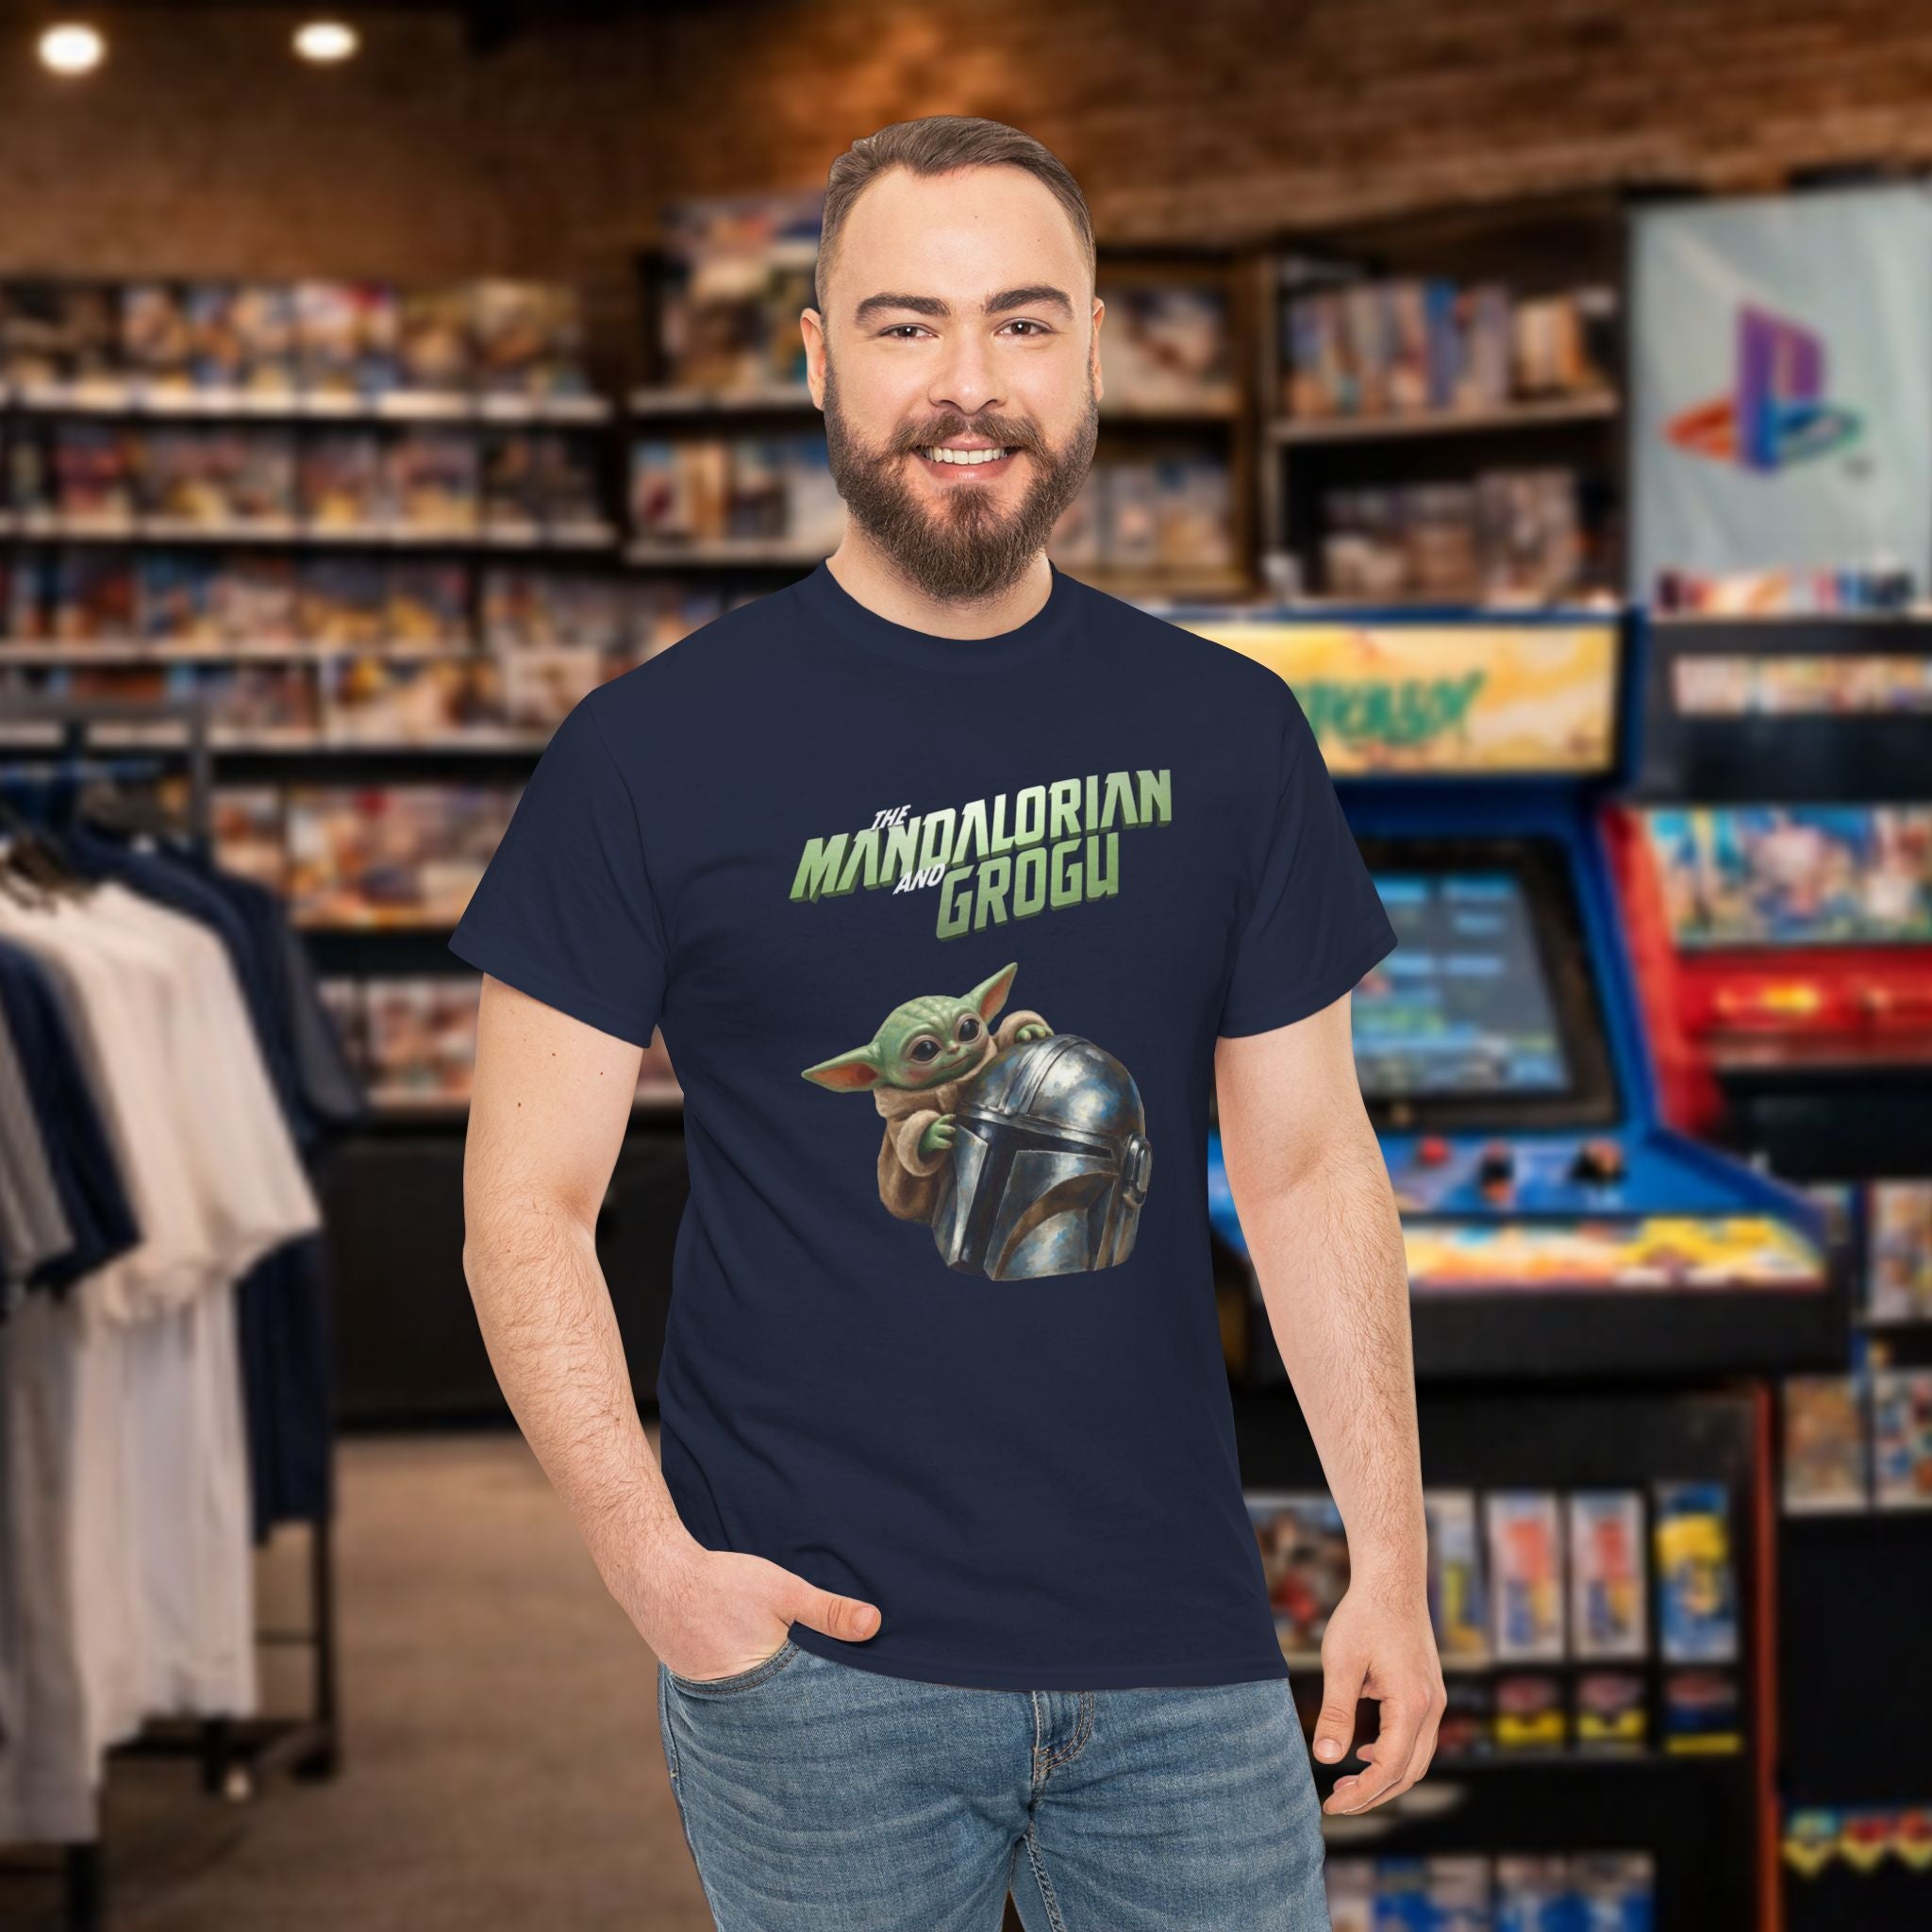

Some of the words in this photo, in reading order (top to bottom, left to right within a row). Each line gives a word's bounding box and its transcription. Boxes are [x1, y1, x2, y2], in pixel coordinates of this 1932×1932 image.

[789, 769, 1173, 904] MANDALORIAN
[870, 805, 911, 831] THE
[892, 862, 946, 895] AND
[936, 831, 1120, 941] GROGU
